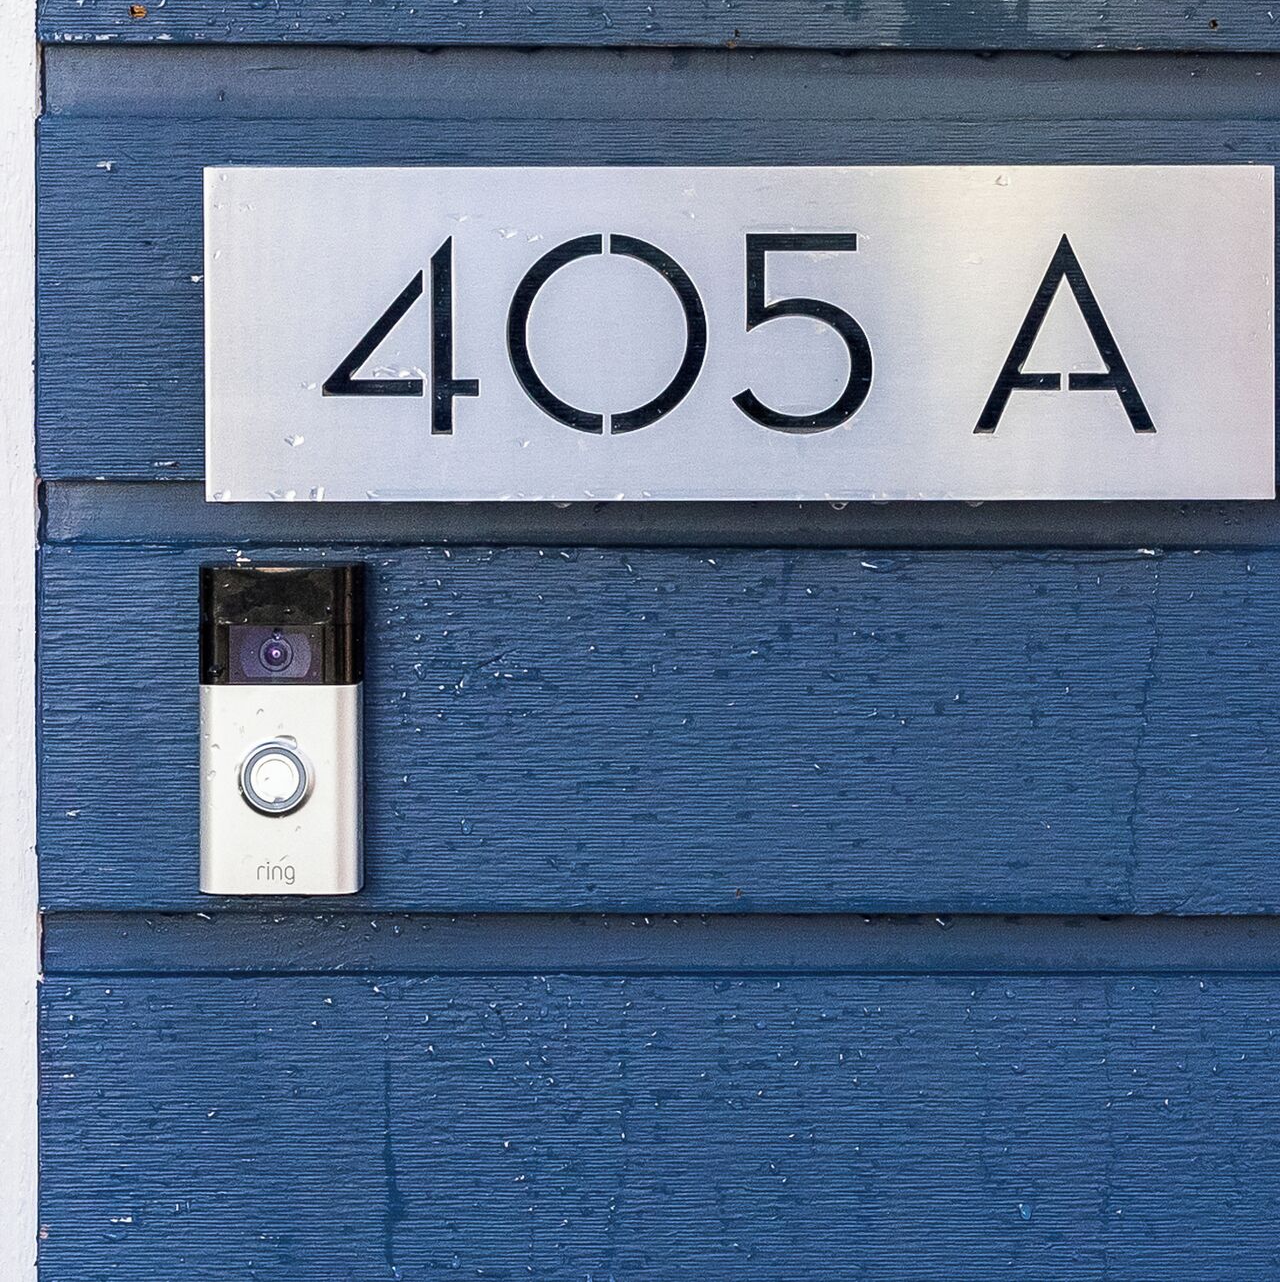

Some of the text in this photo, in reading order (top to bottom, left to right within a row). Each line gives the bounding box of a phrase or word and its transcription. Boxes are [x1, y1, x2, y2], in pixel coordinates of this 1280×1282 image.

[320, 231, 1158, 435] 405 A
[256, 861, 296, 886] ring
